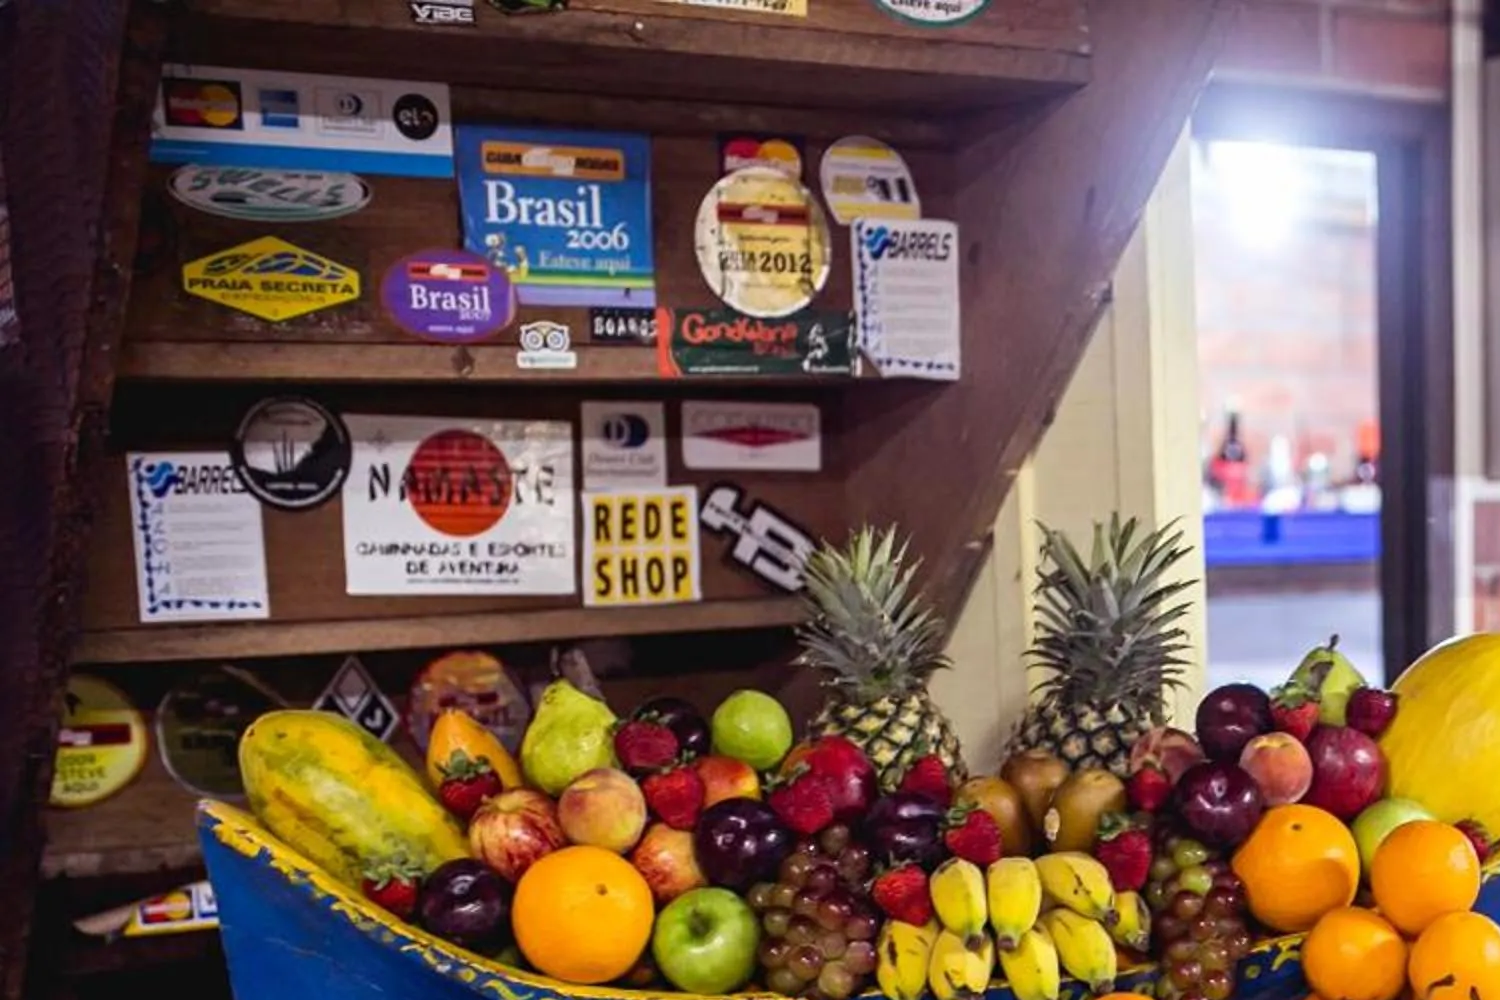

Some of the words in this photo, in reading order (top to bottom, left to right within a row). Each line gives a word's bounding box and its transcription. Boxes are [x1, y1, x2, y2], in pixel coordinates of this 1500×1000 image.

[484, 180, 603, 229] Brasil
[566, 222, 630, 250] 2006
[887, 231, 952, 261] BARRELS
[539, 251, 591, 269] Esteve
[595, 254, 631, 276] aqui
[760, 251, 813, 274] 2012
[189, 278, 253, 291] PRAIA
[260, 280, 354, 295] SECRETA
[409, 283, 489, 311] Brasil
[174, 465, 247, 495] BARREL
[368, 462, 555, 506] NAMASTE
[594, 501, 687, 541] REDE
[469, 543, 478, 556] E
[406, 561, 429, 575] DE
[595, 556, 689, 597] SHOP
